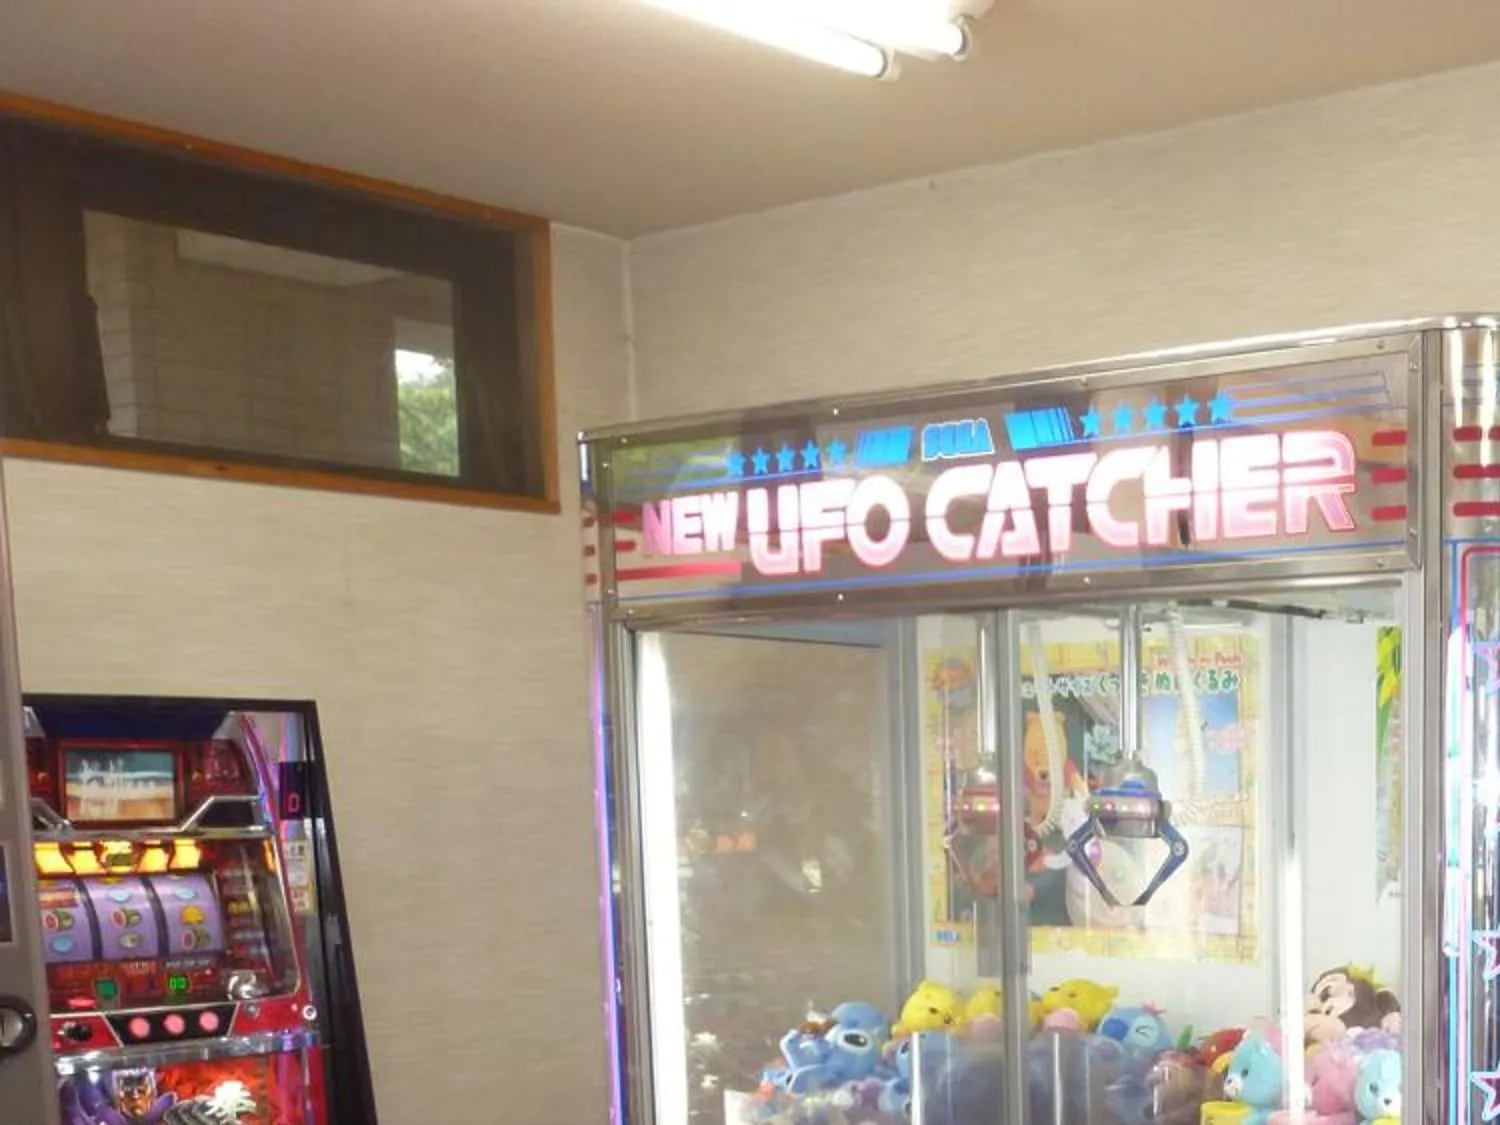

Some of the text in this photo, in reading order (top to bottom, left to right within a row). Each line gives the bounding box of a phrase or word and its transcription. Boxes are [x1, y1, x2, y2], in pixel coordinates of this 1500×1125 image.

[643, 429, 1358, 576] NEW UFO CATCHER
